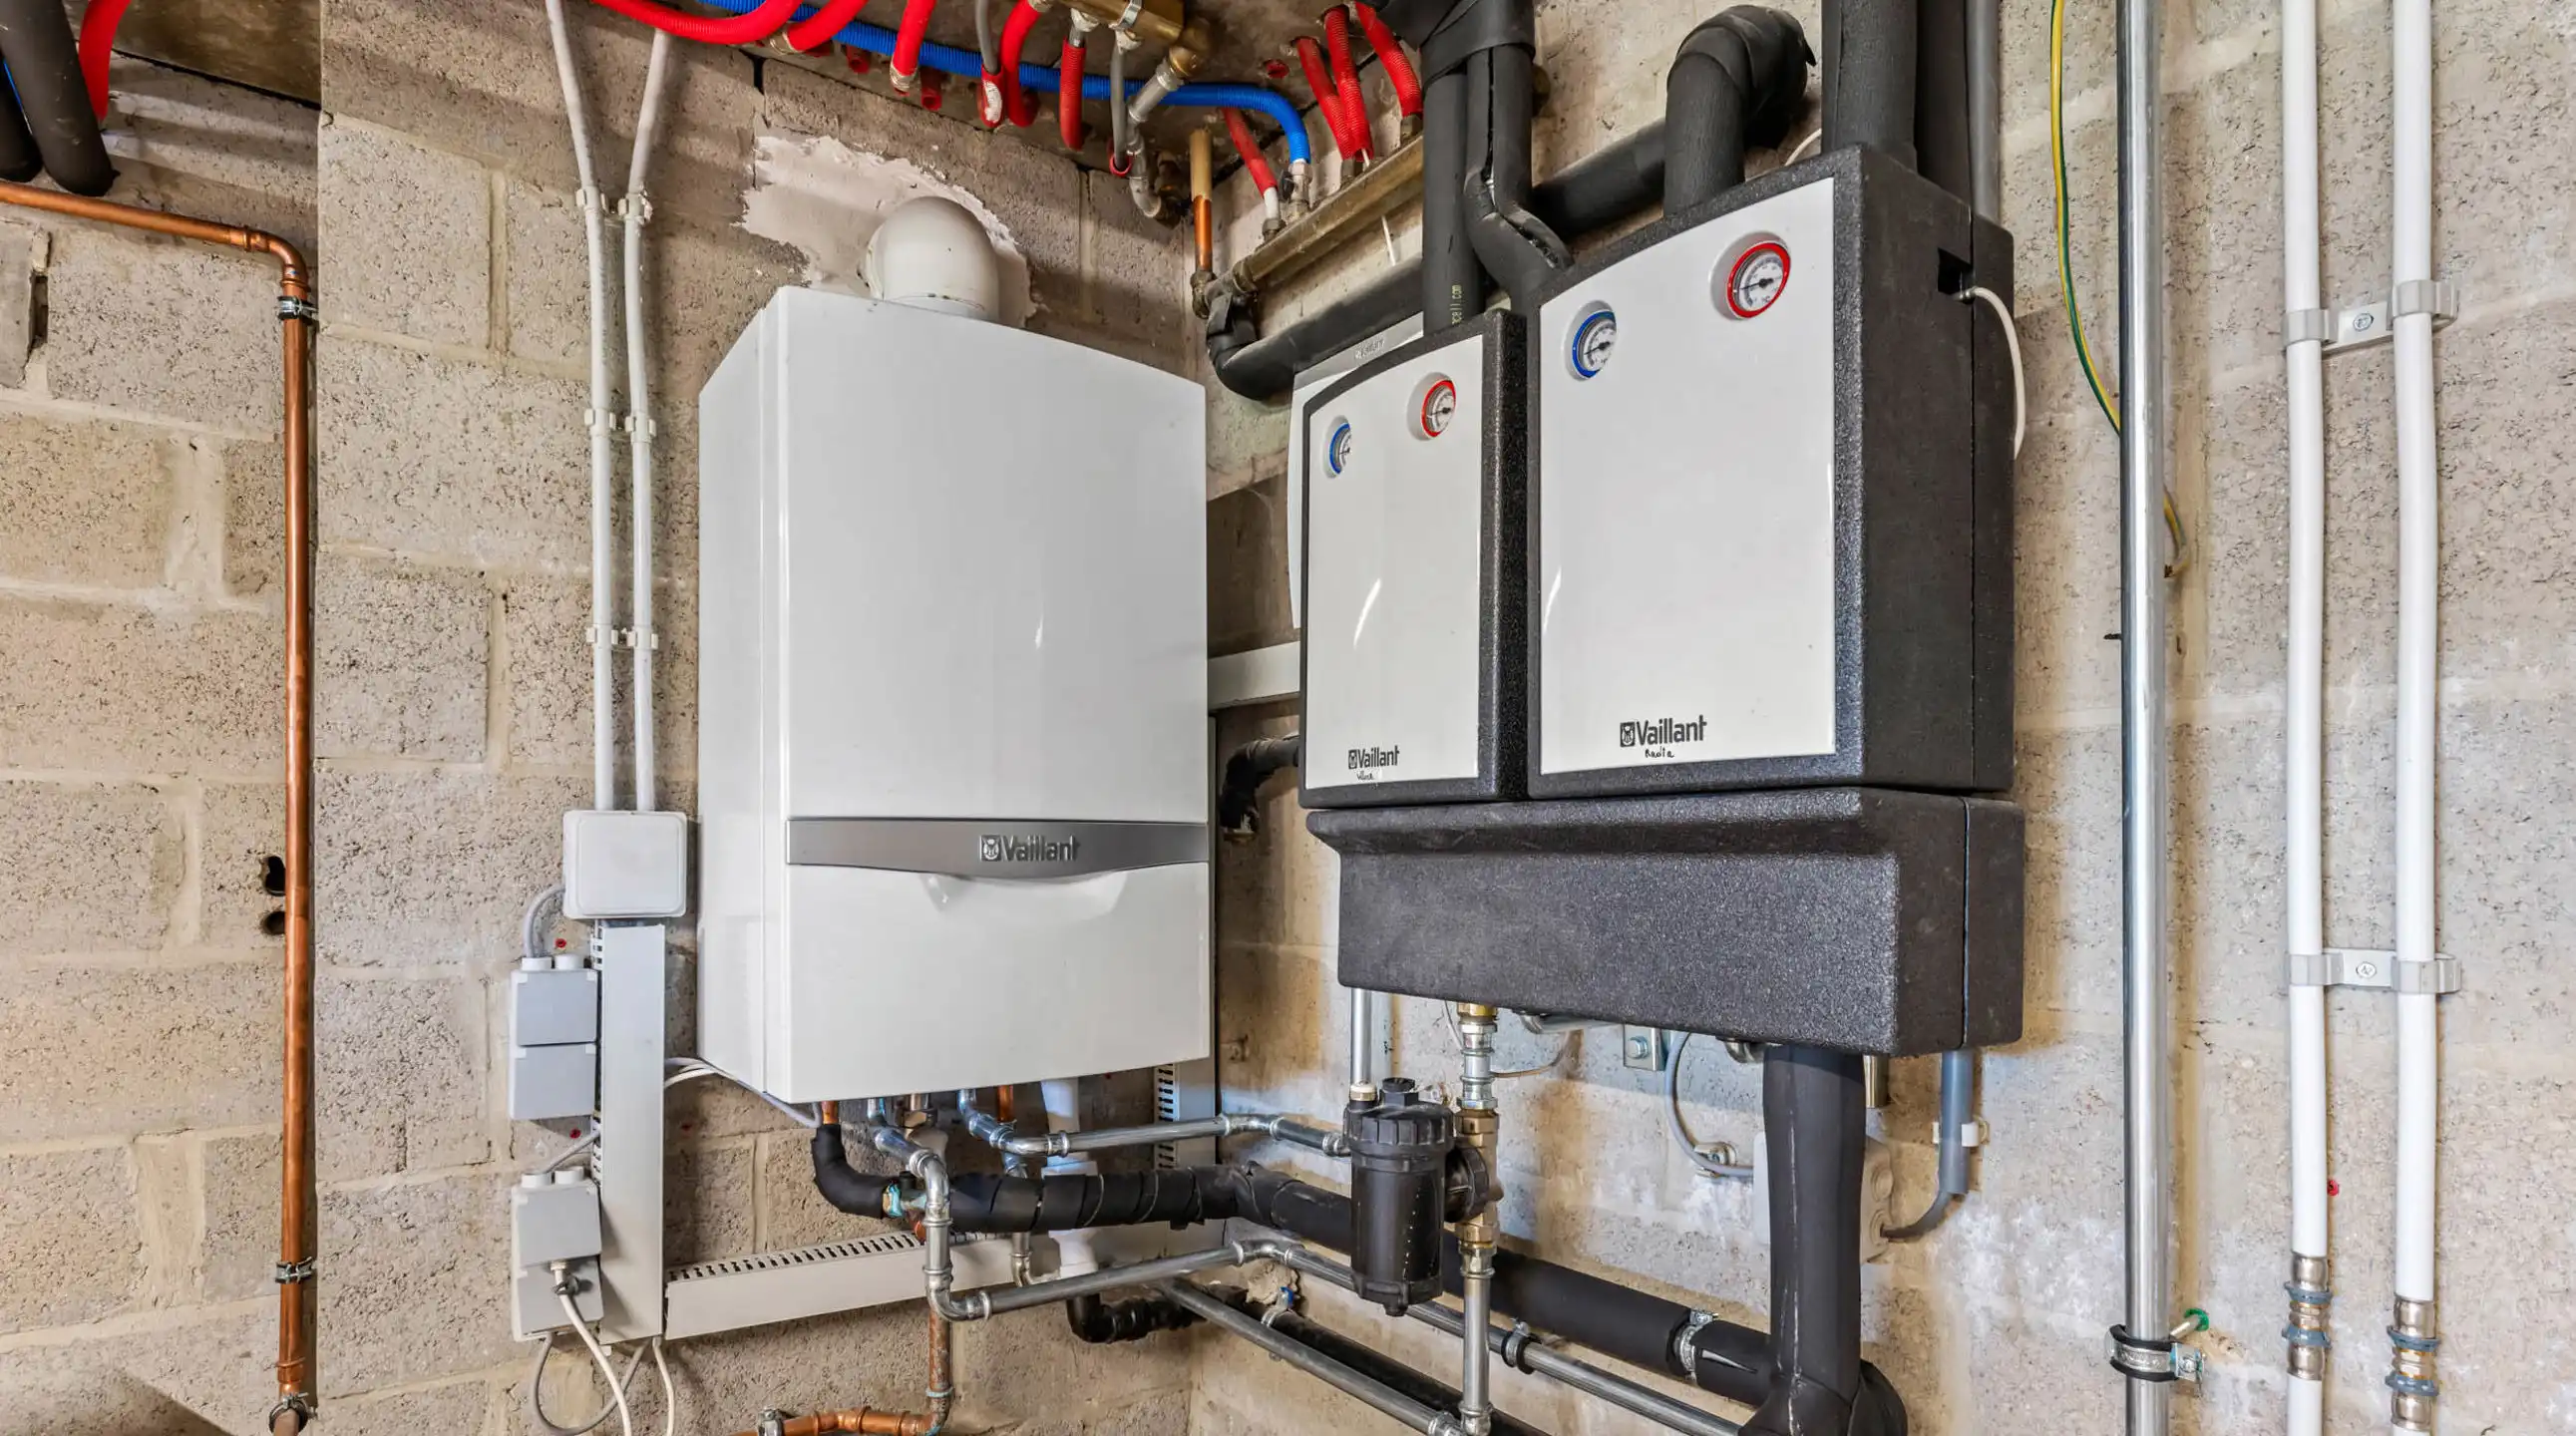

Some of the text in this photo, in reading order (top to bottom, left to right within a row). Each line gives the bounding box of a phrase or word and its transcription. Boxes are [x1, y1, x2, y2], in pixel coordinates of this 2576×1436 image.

[1637, 714, 1707, 746] Vaillant
[1357, 745, 1400, 768] Vaillant
[1000, 835, 1080, 862] Vaillant
